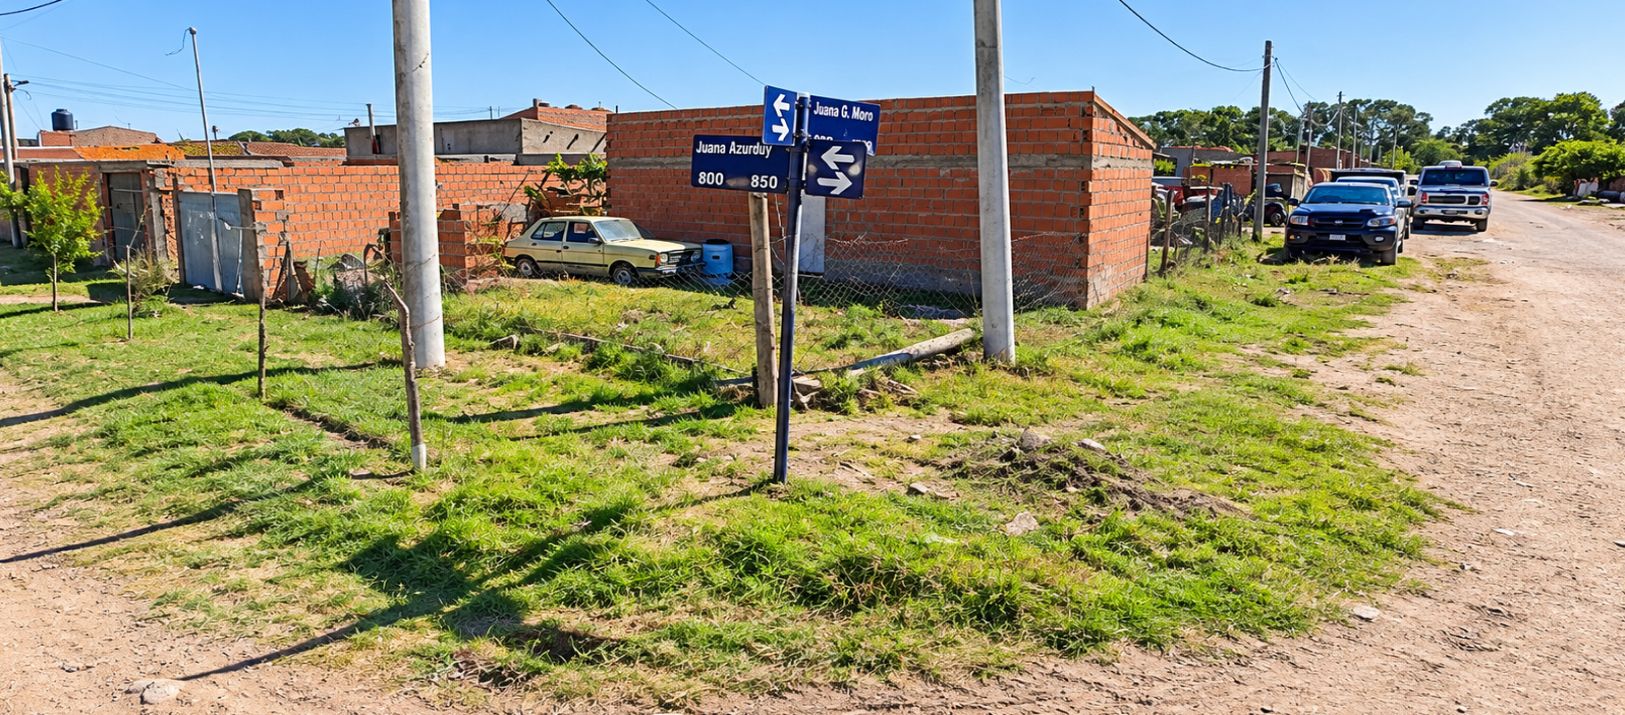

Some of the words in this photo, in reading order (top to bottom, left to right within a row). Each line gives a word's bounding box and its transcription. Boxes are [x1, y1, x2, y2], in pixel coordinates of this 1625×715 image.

[813, 101, 839, 117] Juana
[841, 105, 850, 119] G.
[851, 107, 873, 122] Moro
[695, 140, 726, 154] Juana
[728, 141, 772, 159] Azurduy
[698, 171, 724, 186] 800
[750, 175, 778, 189] 850
